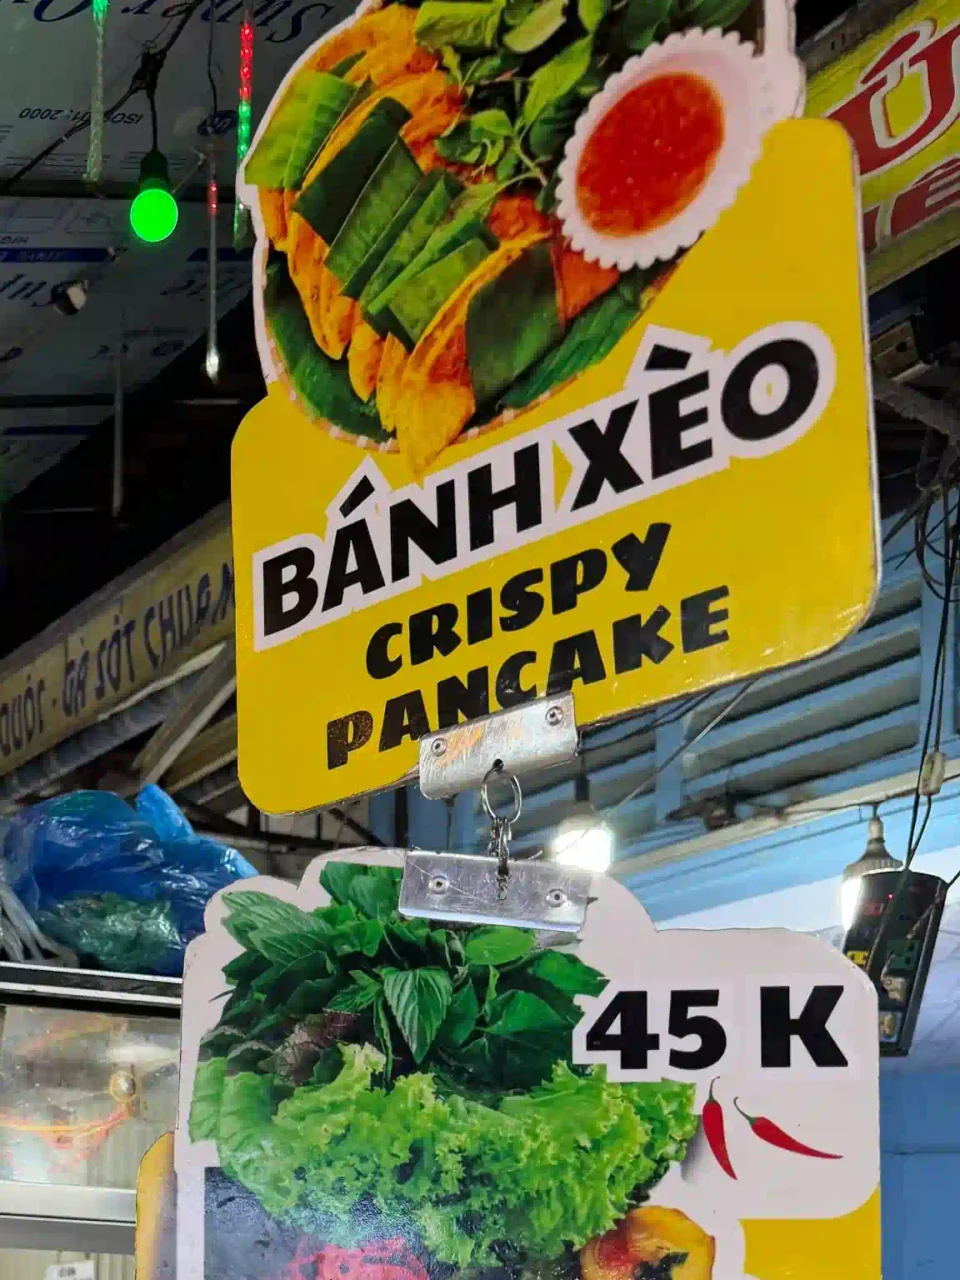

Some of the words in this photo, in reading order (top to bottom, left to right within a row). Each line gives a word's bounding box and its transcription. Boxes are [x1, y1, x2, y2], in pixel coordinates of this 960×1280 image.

[262, 443, 543, 635] BÁNH
[569, 338, 820, 510] XÈO
[326, 585, 730, 771] PANCAKE
[365, 522, 672, 680] CRISPY
[585, 986, 728, 1071] 45
[759, 984, 849, 1069] K
